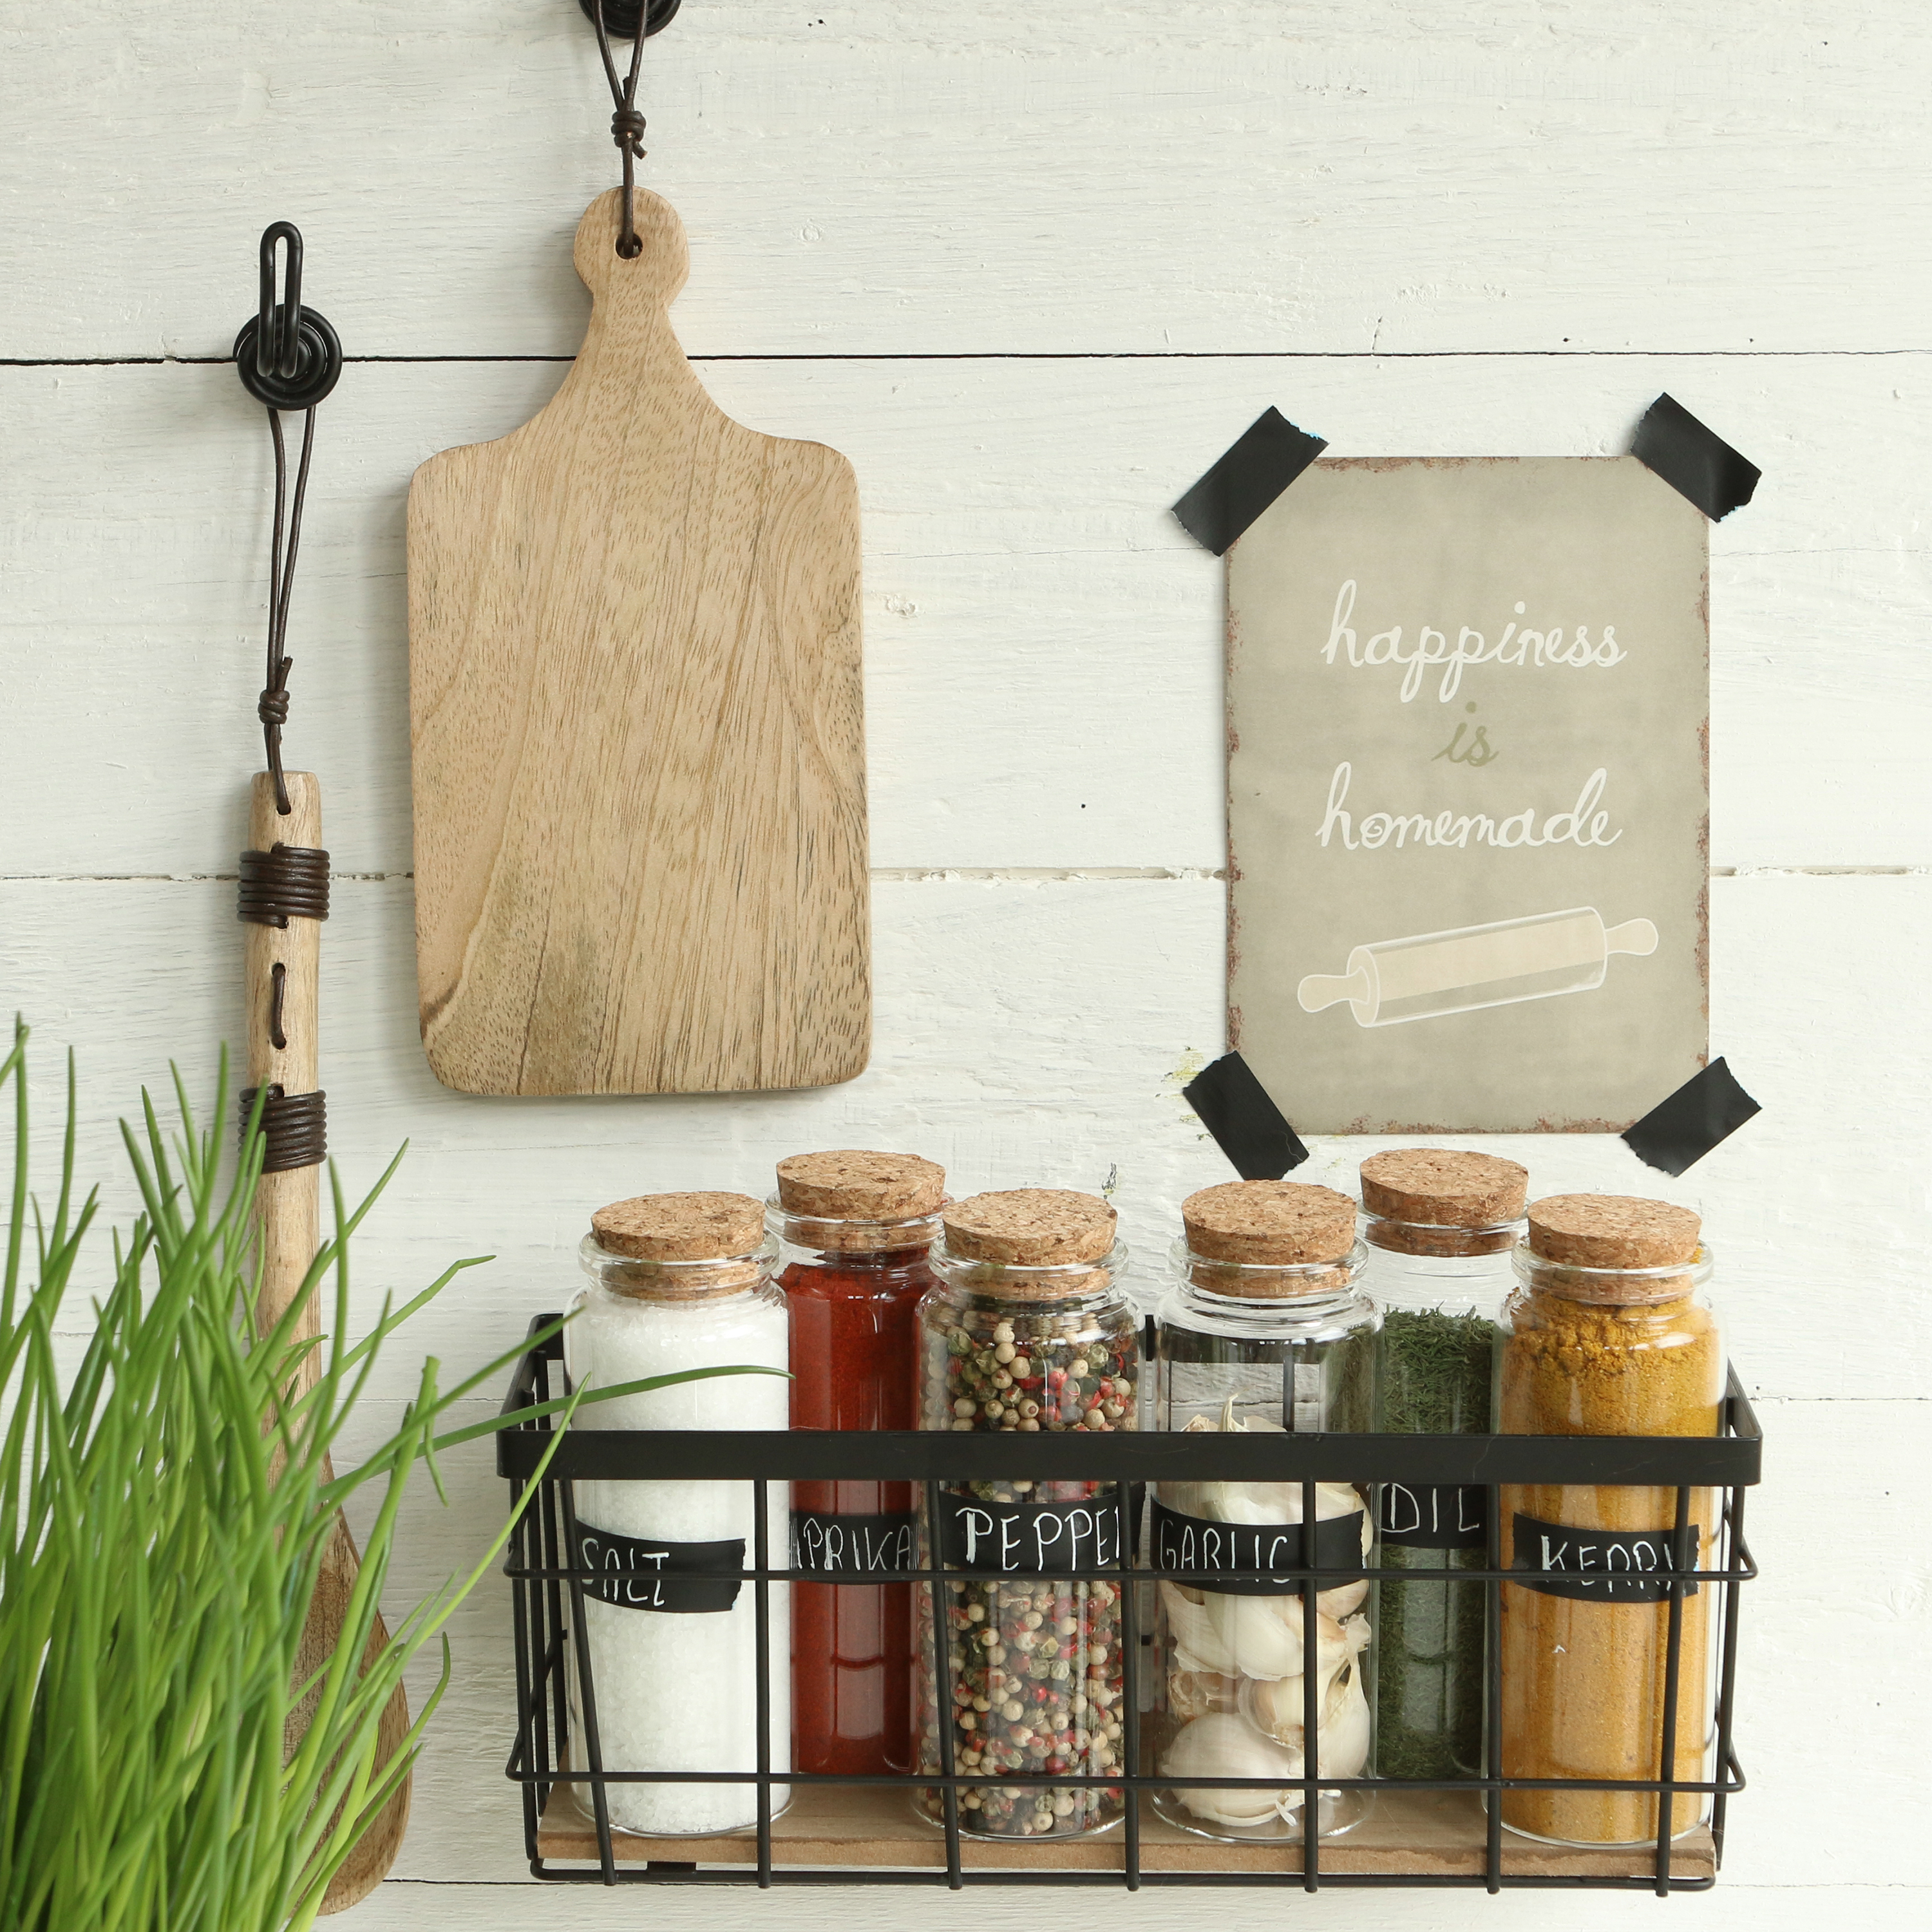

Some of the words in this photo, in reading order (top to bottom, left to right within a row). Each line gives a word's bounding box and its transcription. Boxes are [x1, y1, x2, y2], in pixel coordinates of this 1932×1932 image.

[1320, 579, 1627, 703] happiness
[1431, 701, 1500, 768] is
[1315, 761, 1623, 850] homemade
[582, 1537, 670, 1607] SALT
[1160, 1519, 1291, 1584] GARLIC
